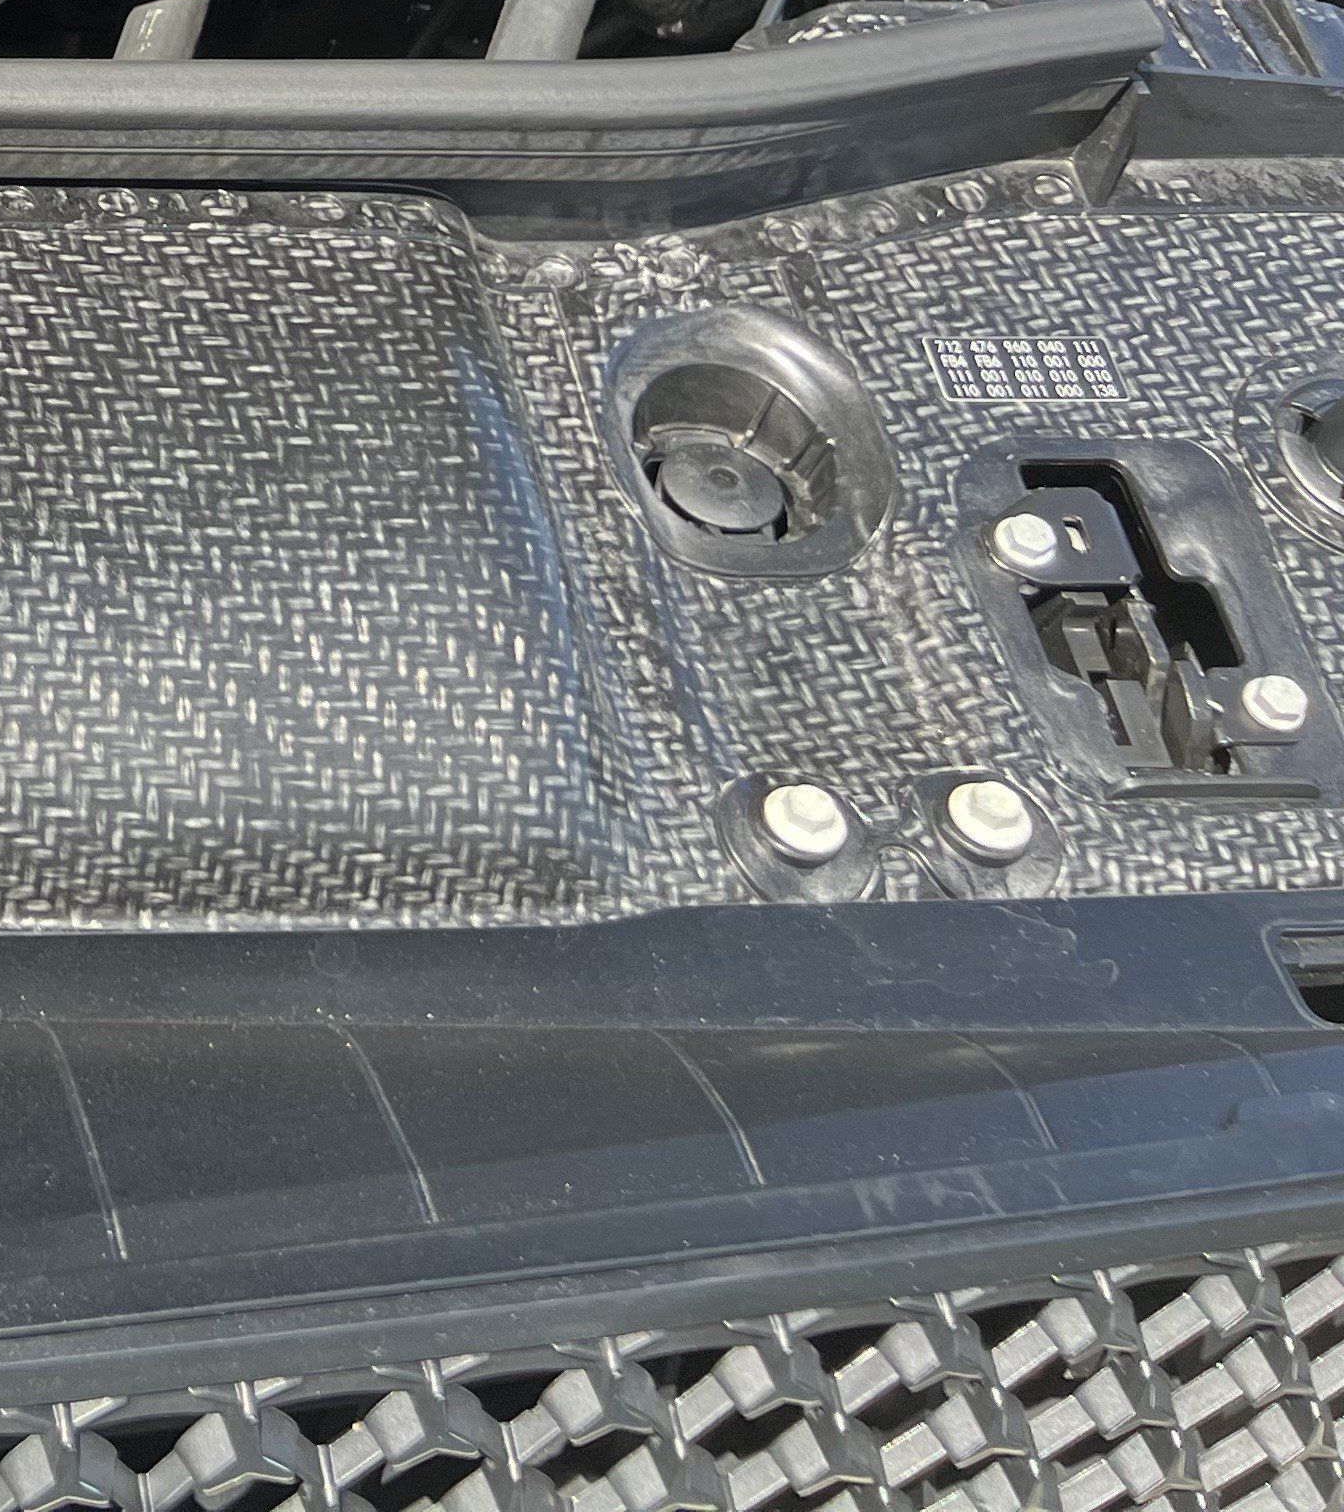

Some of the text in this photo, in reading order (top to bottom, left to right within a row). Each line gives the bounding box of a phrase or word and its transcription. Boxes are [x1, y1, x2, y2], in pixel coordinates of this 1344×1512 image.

[934, 340, 1100, 354] 712 476 960 040 111
[1011, 354, 1039, 369] 110
[1042, 354, 1072, 369] 001
[1077, 354, 1108, 369] 000
[947, 369, 1114, 384] 111 001 010 010 010
[953, 384, 982, 398] 110
[985, 384, 1015, 398] 001
[1020, 384, 1050, 398] 011
[1055, 384, 1086, 398] 000
